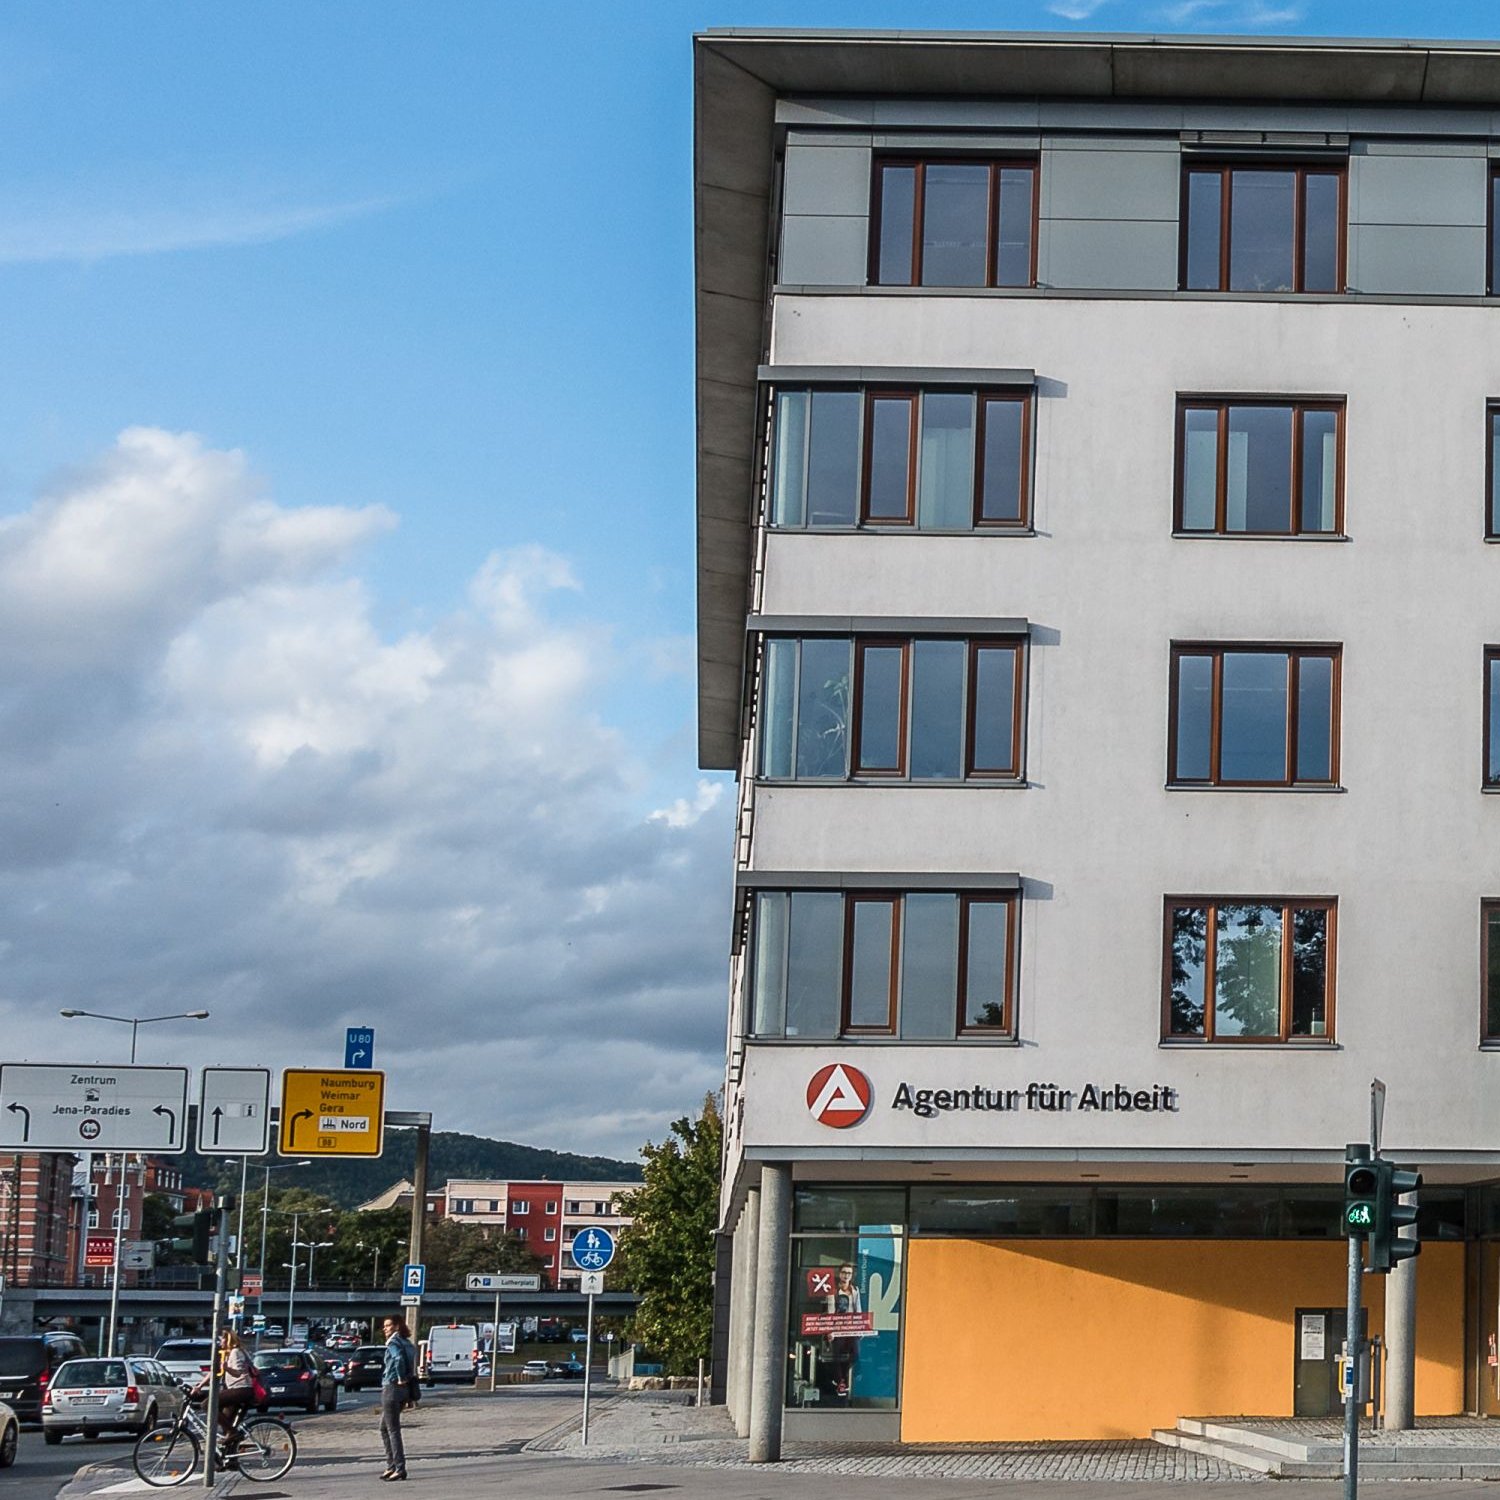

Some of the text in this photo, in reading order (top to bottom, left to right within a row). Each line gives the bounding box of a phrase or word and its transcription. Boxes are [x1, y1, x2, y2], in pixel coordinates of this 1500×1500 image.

[349, 1034, 371, 1044] U 80
[70, 1074, 116, 1085] Zentrum
[321, 1078, 375, 1090] Naumburg
[321, 1091, 360, 1100] Weimar
[892, 1083, 1175, 1117] Agentur für Arbeit
[52, 1104, 131, 1116] Jena-Paradies
[320, 1103, 344, 1112] Gera
[341, 1120, 366, 1129] Nord
